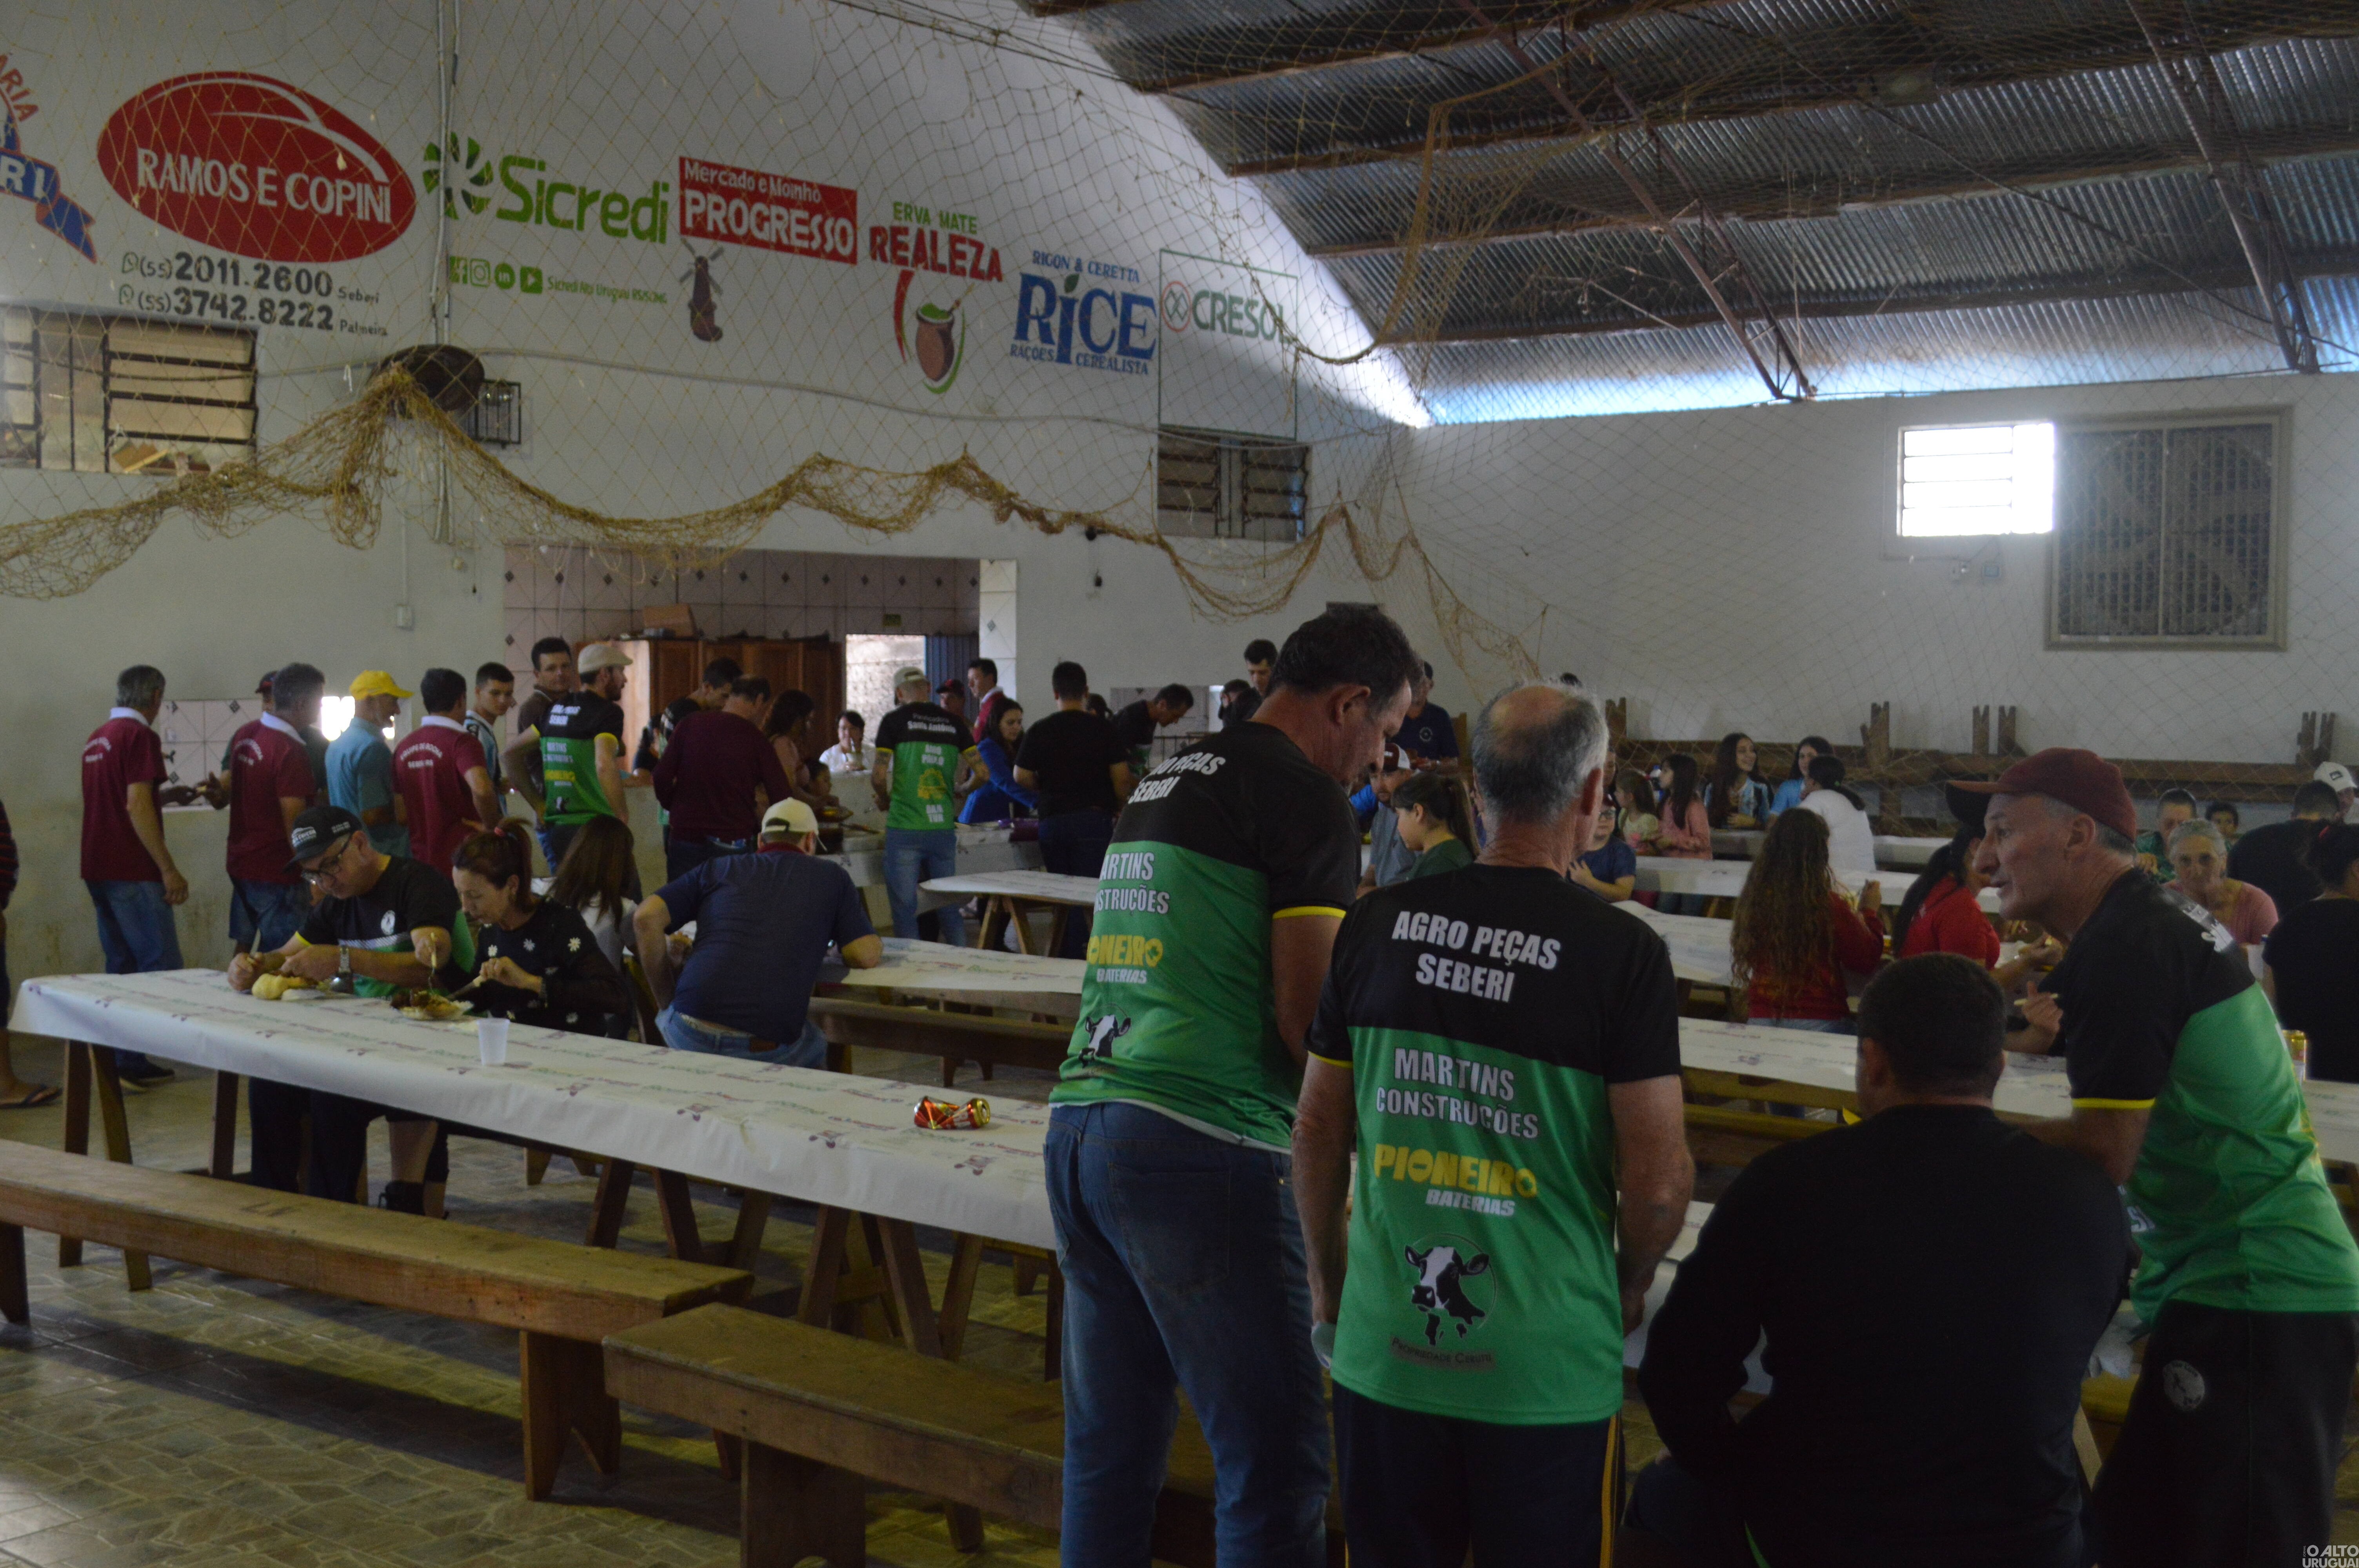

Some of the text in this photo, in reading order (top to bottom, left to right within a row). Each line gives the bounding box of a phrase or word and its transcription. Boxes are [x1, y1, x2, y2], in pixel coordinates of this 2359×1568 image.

[136, 147, 392, 224] RAMOS E COPINI
[496, 155, 669, 244] Sicredi
[684, 159, 821, 204] Mercado e Moinho
[684, 189, 854, 257] PROGRESSO
[893, 201, 978, 234] ERVA MATE
[140, 251, 379, 304] (55) 2011.2600 Seberi
[869, 226, 1003, 282] REALEZA
[1074, 257, 1083, 272] &
[1087, 260, 1140, 283] CERETTA
[547, 275, 578, 293] Sicredi
[138, 286, 388, 336] (55) 3742.8222 Palmeira
[1192, 289, 1293, 345] CRESOL
[1076, 352, 1149, 375] CEREALISTA
[1128, 776, 1181, 804] SEBERI
[1099, 852, 1154, 881] ARTINS
[1392, 911, 1561, 970] AGRO PEÇAS
[1096, 968, 1147, 984] BATERIAS
[1415, 953, 1515, 1003] SEBERI
[1394, 1047, 1515, 1102] MARTINS
[1375, 1087, 1539, 1139] CONSTRUÇÕES
[1374, 1143, 1538, 1199] PIONEIRO
[1426, 1188, 1516, 1217] BATERIAS
